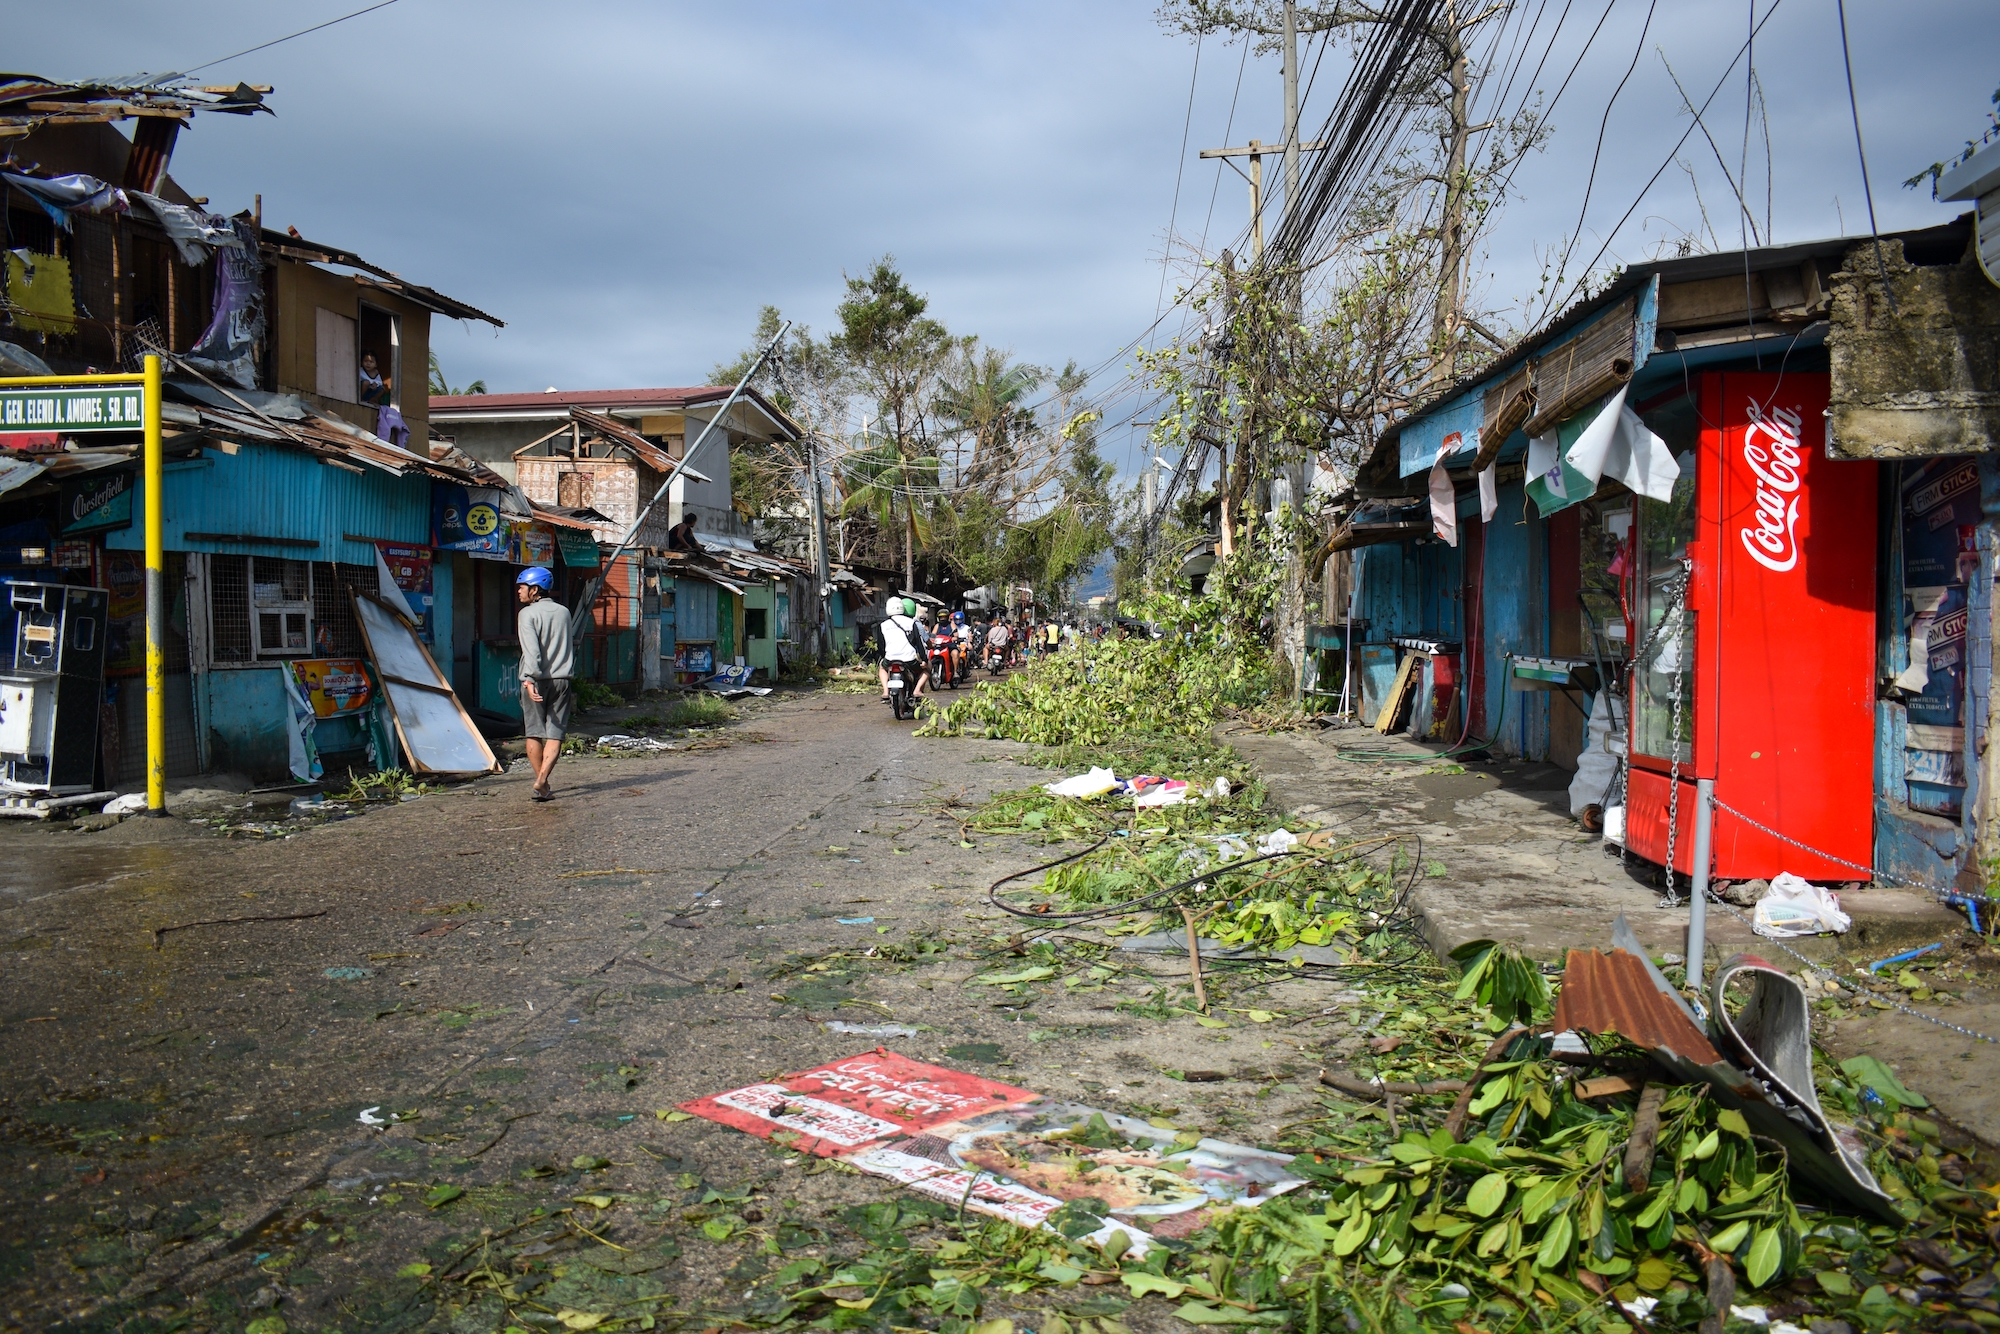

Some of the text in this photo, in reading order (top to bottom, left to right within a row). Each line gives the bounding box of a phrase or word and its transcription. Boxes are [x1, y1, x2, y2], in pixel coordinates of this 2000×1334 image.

[6, 400, 26, 424] GEN.
[27, 399, 54, 424] ELENO
[55, 399, 65, 423] A.
[108, 397, 124, 421] SR.
[124, 396, 140, 421] RD.
[73, 474, 124, 521] Chesterfield
[1741, 395, 1803, 573] Coca-Cola
[1916, 465, 1977, 509] FIRM STICK
[401, 567, 413, 576] GB
[804, 1069, 954, 1115] DELIVERY
[836, 1062, 965, 1103] Chowking
[917, 1165, 976, 1188] FREE
